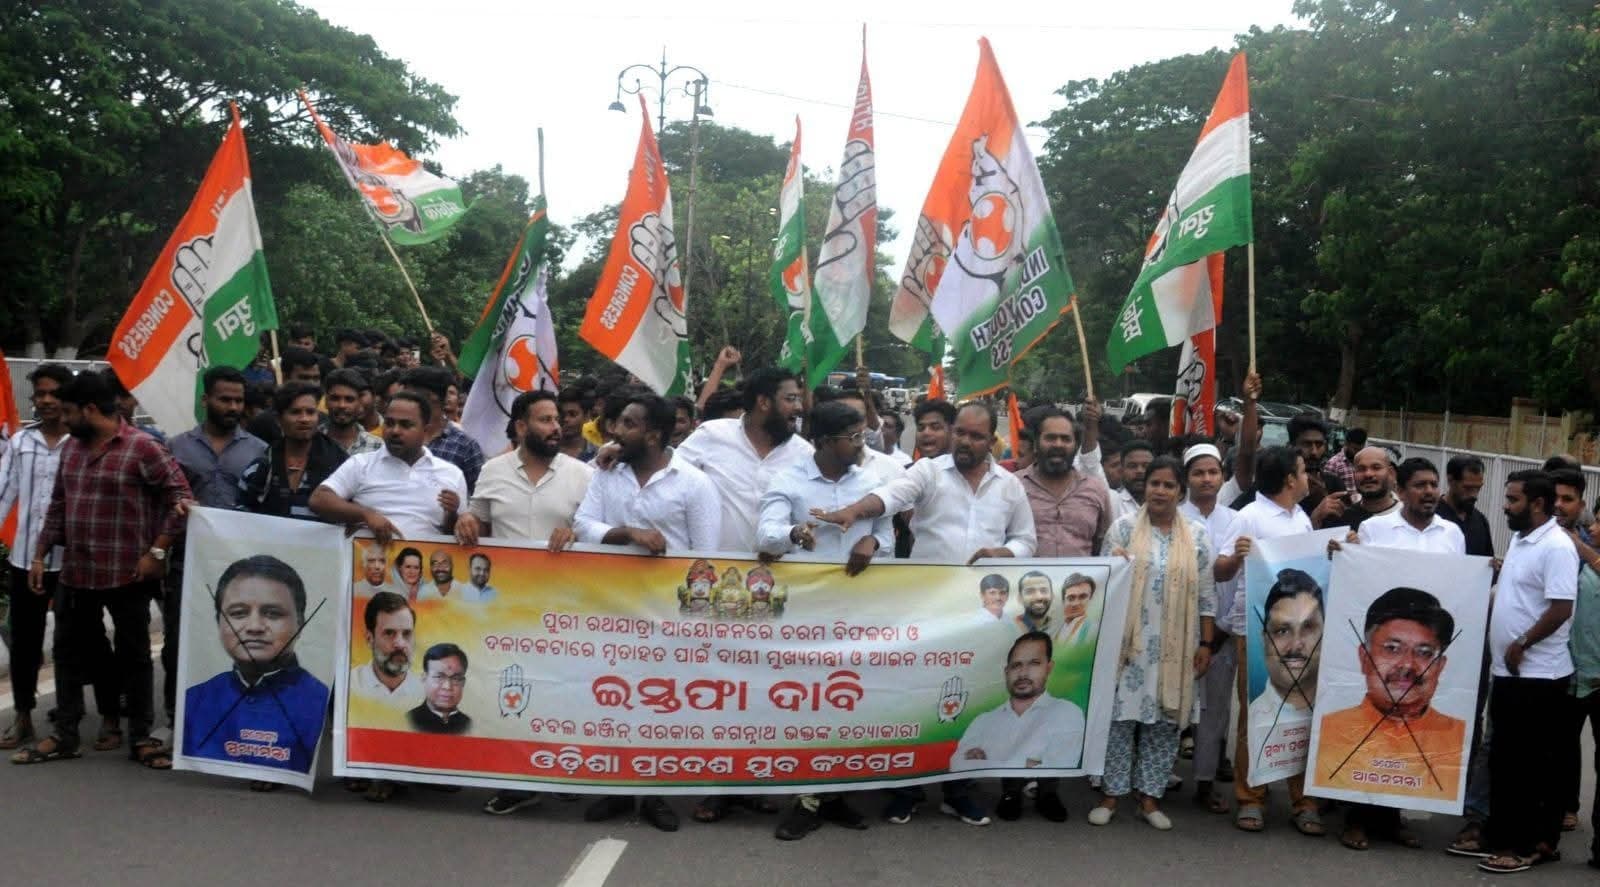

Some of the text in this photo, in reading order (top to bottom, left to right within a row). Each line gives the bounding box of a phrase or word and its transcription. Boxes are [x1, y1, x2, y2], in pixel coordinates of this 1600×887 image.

[543, 613, 919, 641] ପୁରୀ ରଥଯାତ୍ରା ଆୟୋଜନରେ ଚରମ ବିଫଳତା ଓ
[485, 635, 975, 670] ଦଳାଚକଟାରେ ମୃତାହତ ପାଇଁ ଦାୟୀ ମୁଖ୍ୟମନ୍ତ୍ରୀ ଓ ଆଇନ ମନ୍ତ୍ରୀଙ୍କ
[592, 670, 864, 714] ଇସ୍ତଫା ଦାବି
[530, 717, 576, 735] ଡବଲ
[638, 723, 705, 740] ସରକାର
[711, 724, 777, 744] ଜଗନ୍ନାଥ
[783, 724, 832, 741] ଭକ୍ତଙ୍କ
[838, 723, 920, 740] ହତ୍ୟାକାରୀ
[530, 745, 915, 779] ଓଡ଼ିଶା ପ୍ରଦେଶ ଯୁବ କଂଗ୍ରେସ
